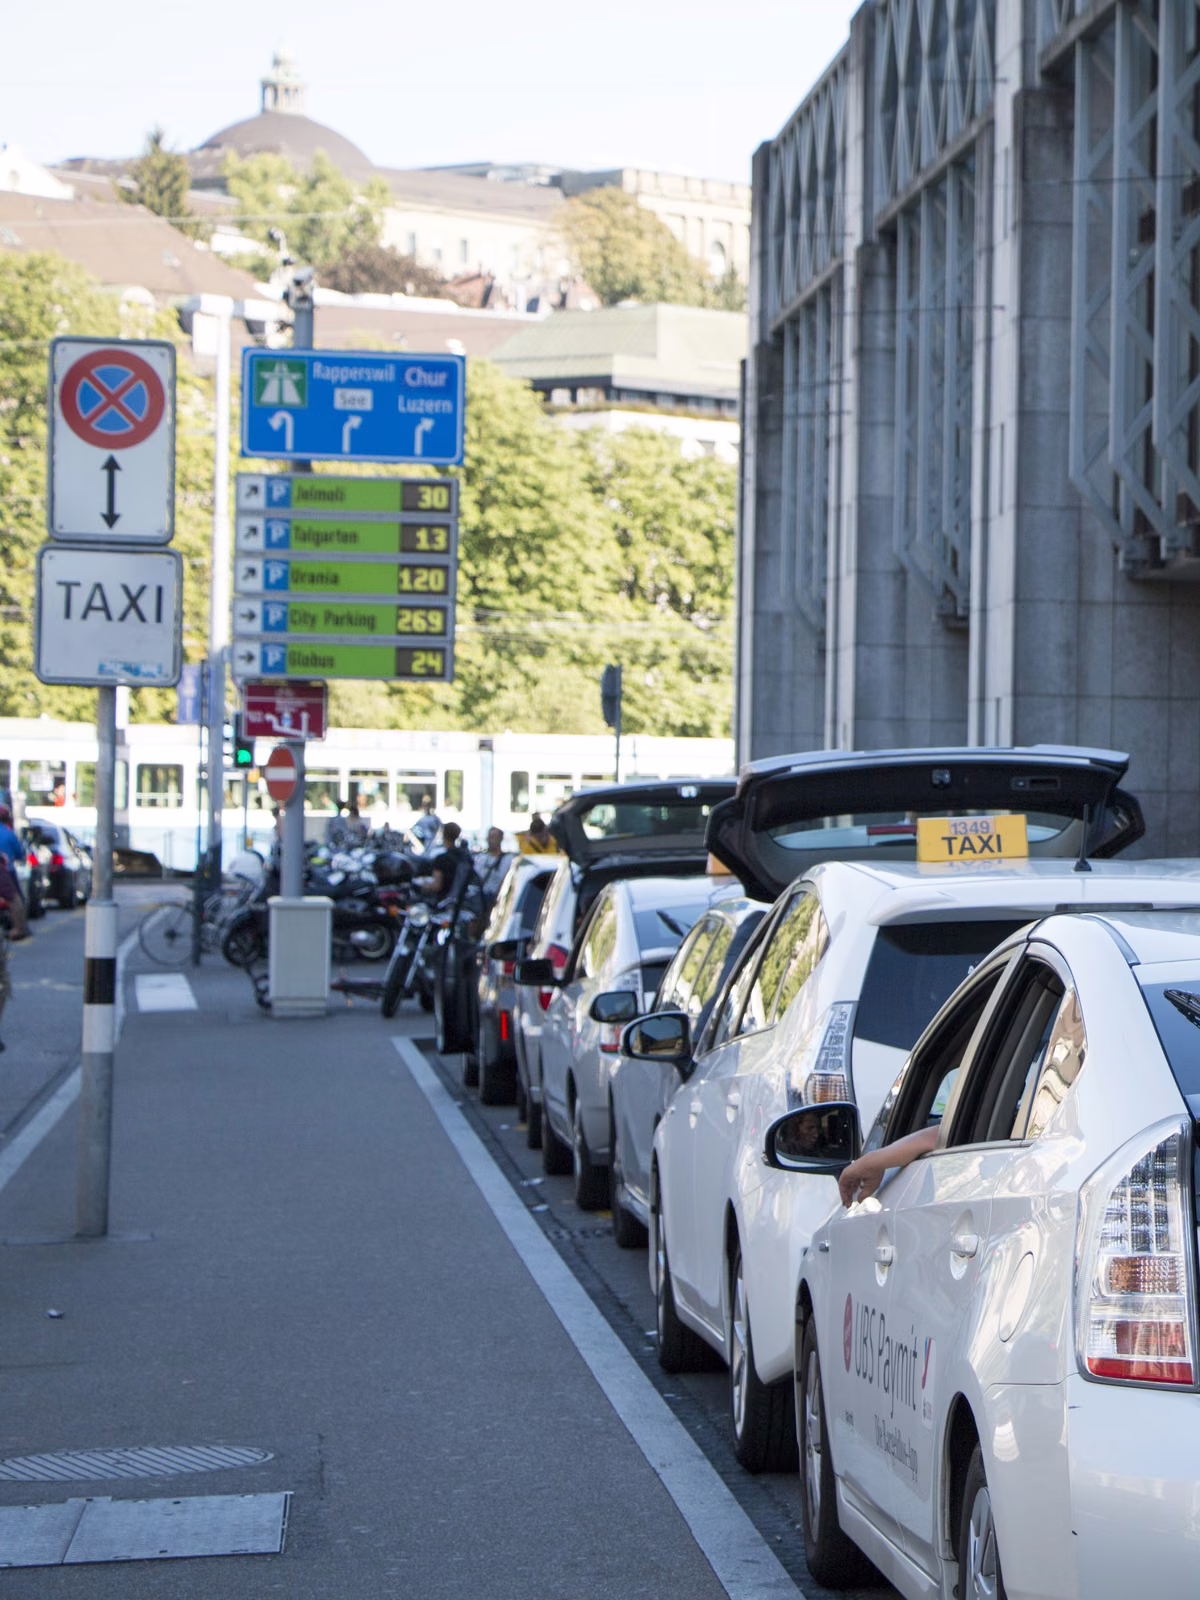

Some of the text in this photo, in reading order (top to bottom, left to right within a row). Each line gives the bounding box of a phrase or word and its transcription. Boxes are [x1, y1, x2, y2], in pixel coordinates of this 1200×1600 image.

[312, 361, 396, 383] Rapperswil
[404, 367, 448, 387] Chur
[338, 390, 367, 406] See
[398, 395, 453, 414] Luzern
[417, 486, 449, 509] 30
[415, 528, 448, 551] 13
[291, 569, 340, 586] Urania
[399, 569, 446, 592] 120
[56, 581, 163, 624] TAXI
[290, 609, 317, 630] City
[324, 609, 377, 632] Parking
[397, 610, 444, 632] 269
[288, 651, 335, 669] Globus
[411, 652, 443, 674] 24
[951, 820, 990, 835] 1349
[941, 834, 1002, 855] TAXI
[854, 1301, 876, 1385] UBS
[878, 1313, 917, 1419] Paymit
